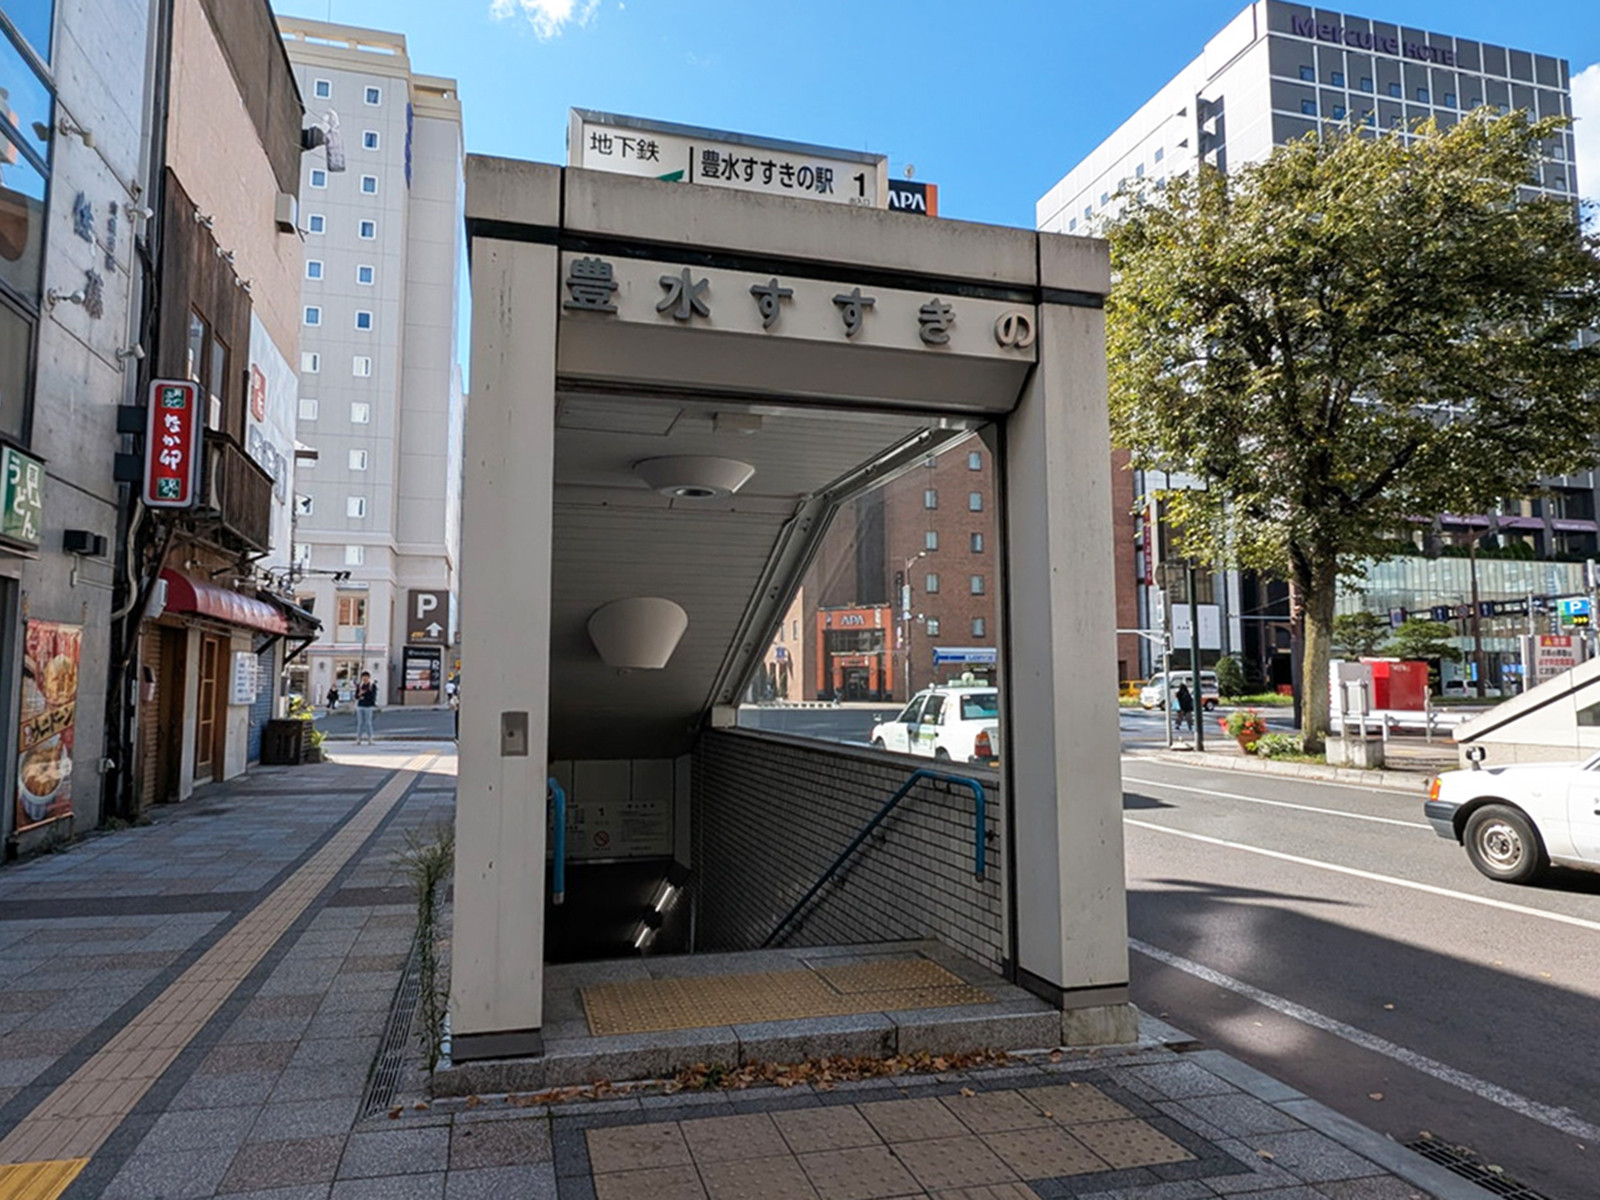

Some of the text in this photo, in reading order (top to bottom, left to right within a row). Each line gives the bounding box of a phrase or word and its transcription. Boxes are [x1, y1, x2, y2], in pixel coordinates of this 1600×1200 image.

[1292, 15, 1399, 53] Mercure
[589, 131, 866, 197] 地下鉄 豊水すすきの駅 1
[887, 189, 927, 211] APA
[563, 256, 1035, 350] 豊水すすきの
[159, 413, 182, 471] なか卯
[417, 594, 438, 619] P
[841, 615, 865, 625] APA
[1569, 601, 1582, 613] P
